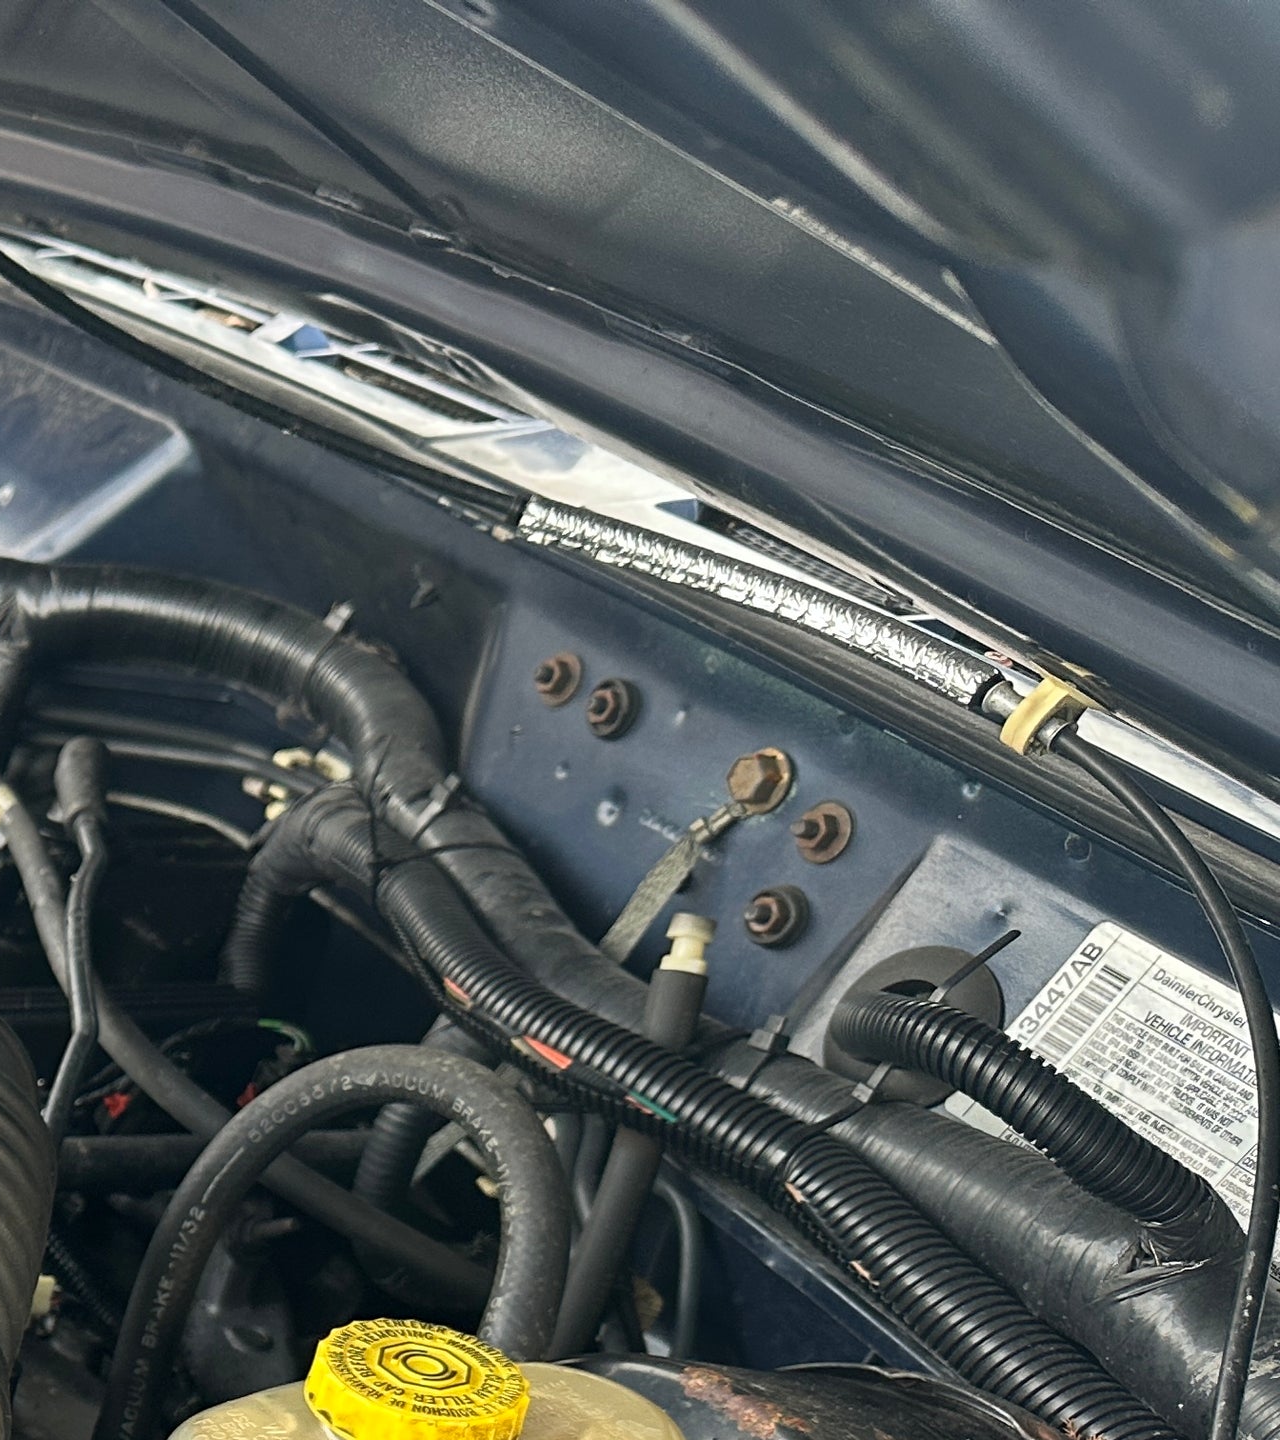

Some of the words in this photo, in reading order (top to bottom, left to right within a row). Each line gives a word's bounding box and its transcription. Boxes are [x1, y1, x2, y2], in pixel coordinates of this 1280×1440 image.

[1142, 1011, 1193, 1046] VEHICLE
[1178, 1012, 1252, 1060] IMPORTANT
[142, 1275, 175, 1350] BRAKE
[355, 1323, 373, 1331] DE
[358, 1328, 434, 1346] REMOVING
[346, 1343, 377, 1379] BEFORE
[375, 1380, 405, 1396] CAP
[390, 1398, 406, 1409] DE
[413, 1393, 475, 1405] FILLER
[411, 1403, 478, 1417] BOUCHON
